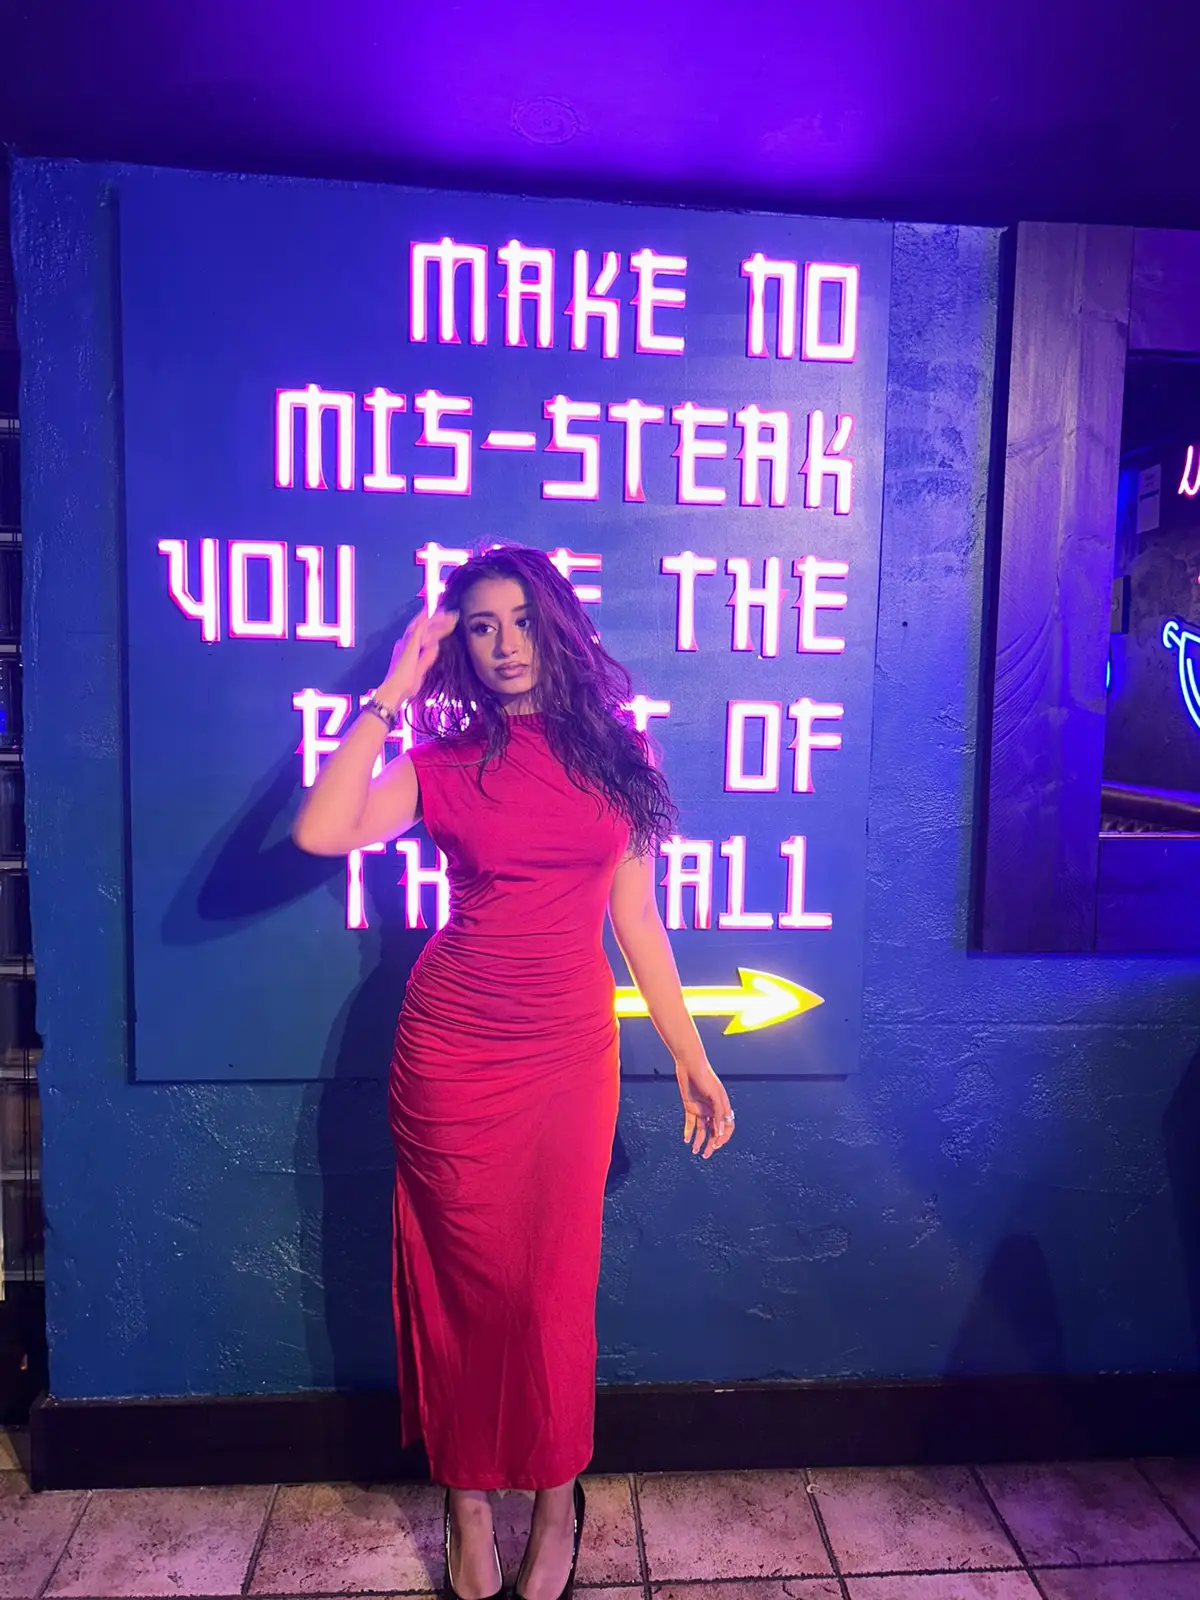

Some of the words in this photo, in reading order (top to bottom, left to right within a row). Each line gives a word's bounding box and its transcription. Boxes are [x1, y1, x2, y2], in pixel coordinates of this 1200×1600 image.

[409, 237, 688, 358] MAKE
[742, 252, 861, 364] NO
[275, 383, 855, 515] MIS-STEAK
[157, 537, 356, 649] YOU
[661, 550, 849, 658] THE
[725, 697, 845, 794] OF
[345, 840, 451, 931] TH
[658, 834, 834, 931] ALL
